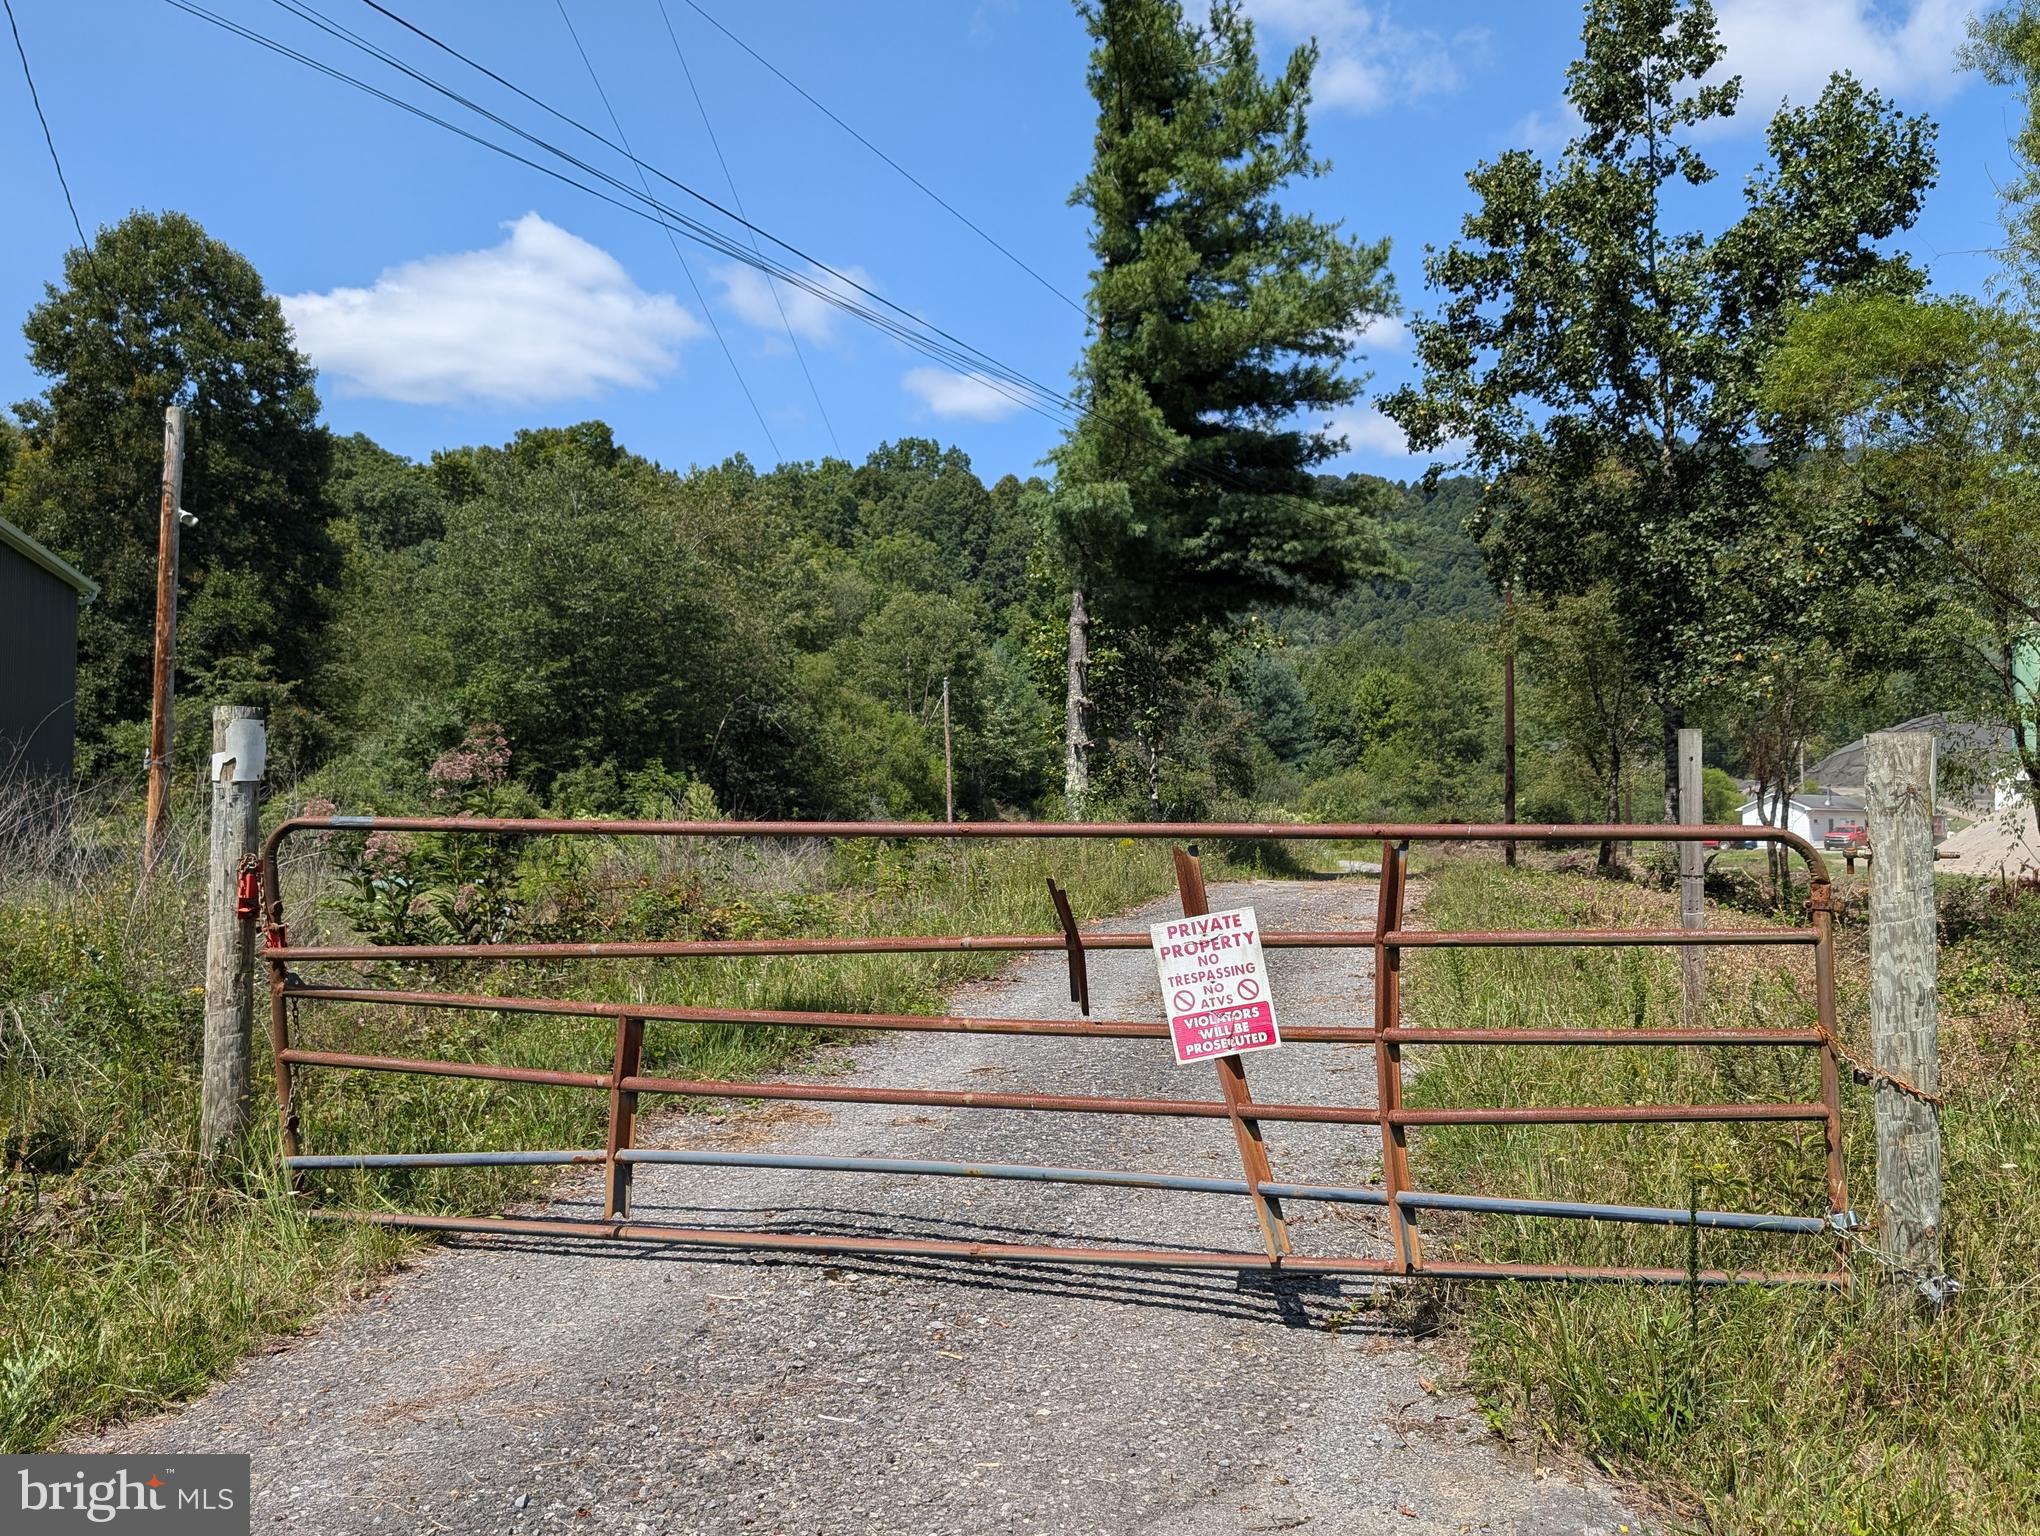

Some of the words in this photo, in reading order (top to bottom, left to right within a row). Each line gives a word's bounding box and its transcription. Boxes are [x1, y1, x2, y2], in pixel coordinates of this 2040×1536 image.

[1167, 914, 1242, 939] PRIVATE
[1160, 931, 1254, 960] PROPERTY
[1197, 953, 1219, 967] NO
[1168, 962, 1255, 988] TRESPASSING
[1203, 983, 1224, 995] NO
[1201, 994, 1233, 1009] ATVS
[1184, 1007, 1259, 1029] VIOLATORS
[1199, 1025, 1232, 1040] WILL
[1234, 1022, 1250, 1034] BE
[1185, 1032, 1268, 1056] PROSECUTED
